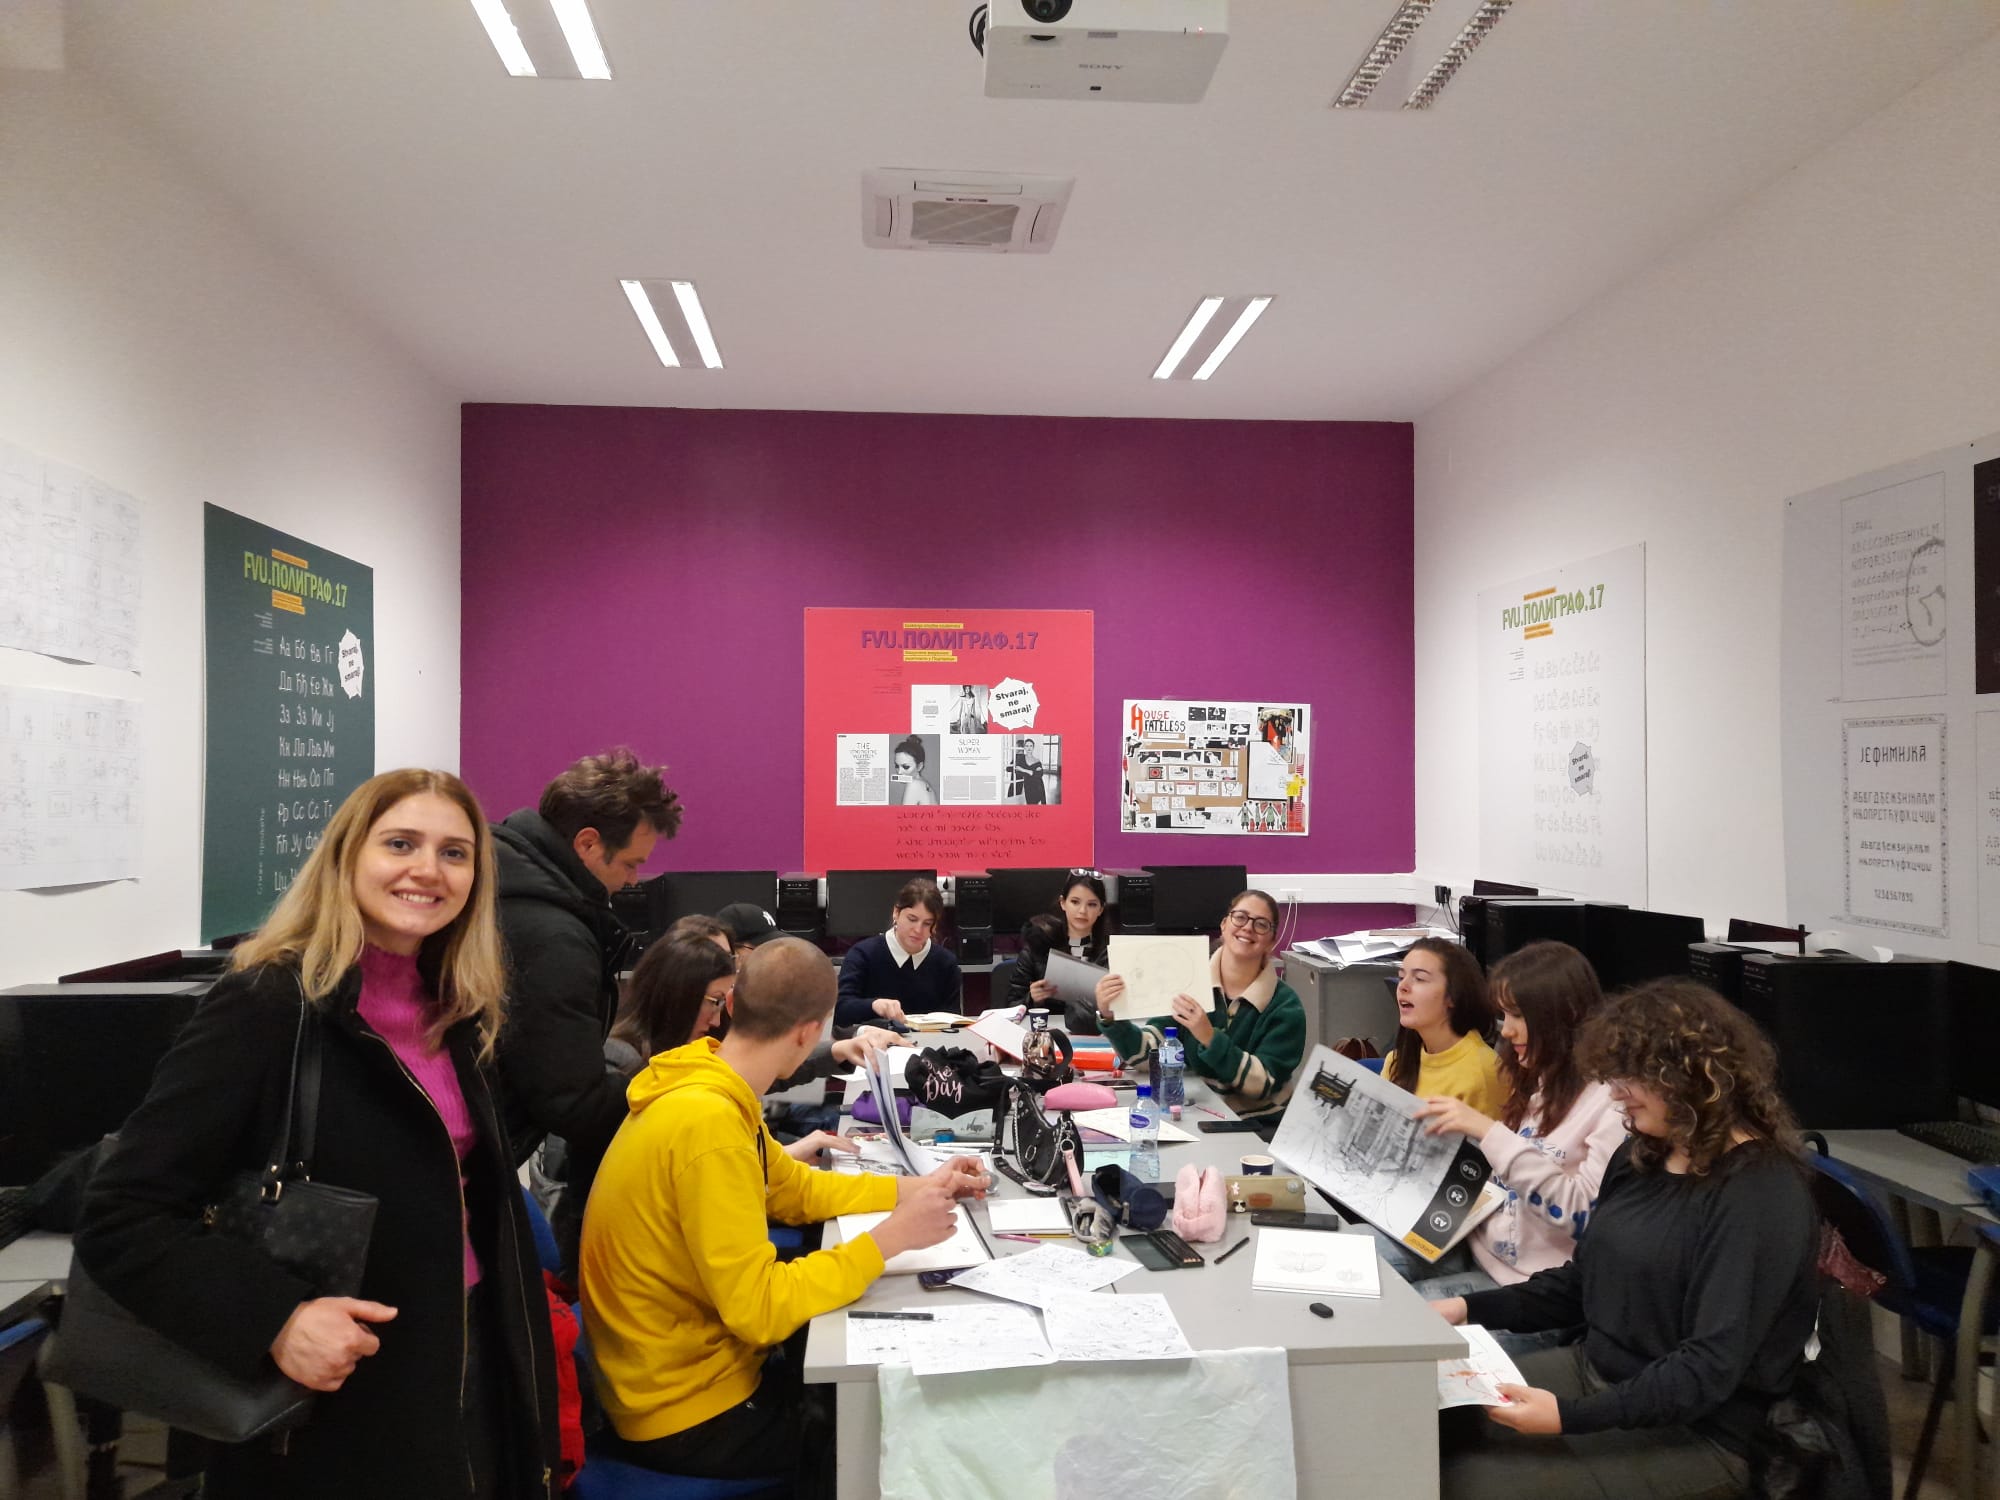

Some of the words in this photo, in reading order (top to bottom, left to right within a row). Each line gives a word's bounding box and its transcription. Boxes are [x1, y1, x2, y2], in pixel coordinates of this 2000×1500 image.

[1008, 699, 1019, 707] ne
[1000, 704, 1033, 718] smaraj!
[1144, 719, 1186, 732] FATELESS
[923, 1073, 963, 1104] Day
[1451, 1190, 1463, 1202] 24
[1433, 1216, 1448, 1228] A3
